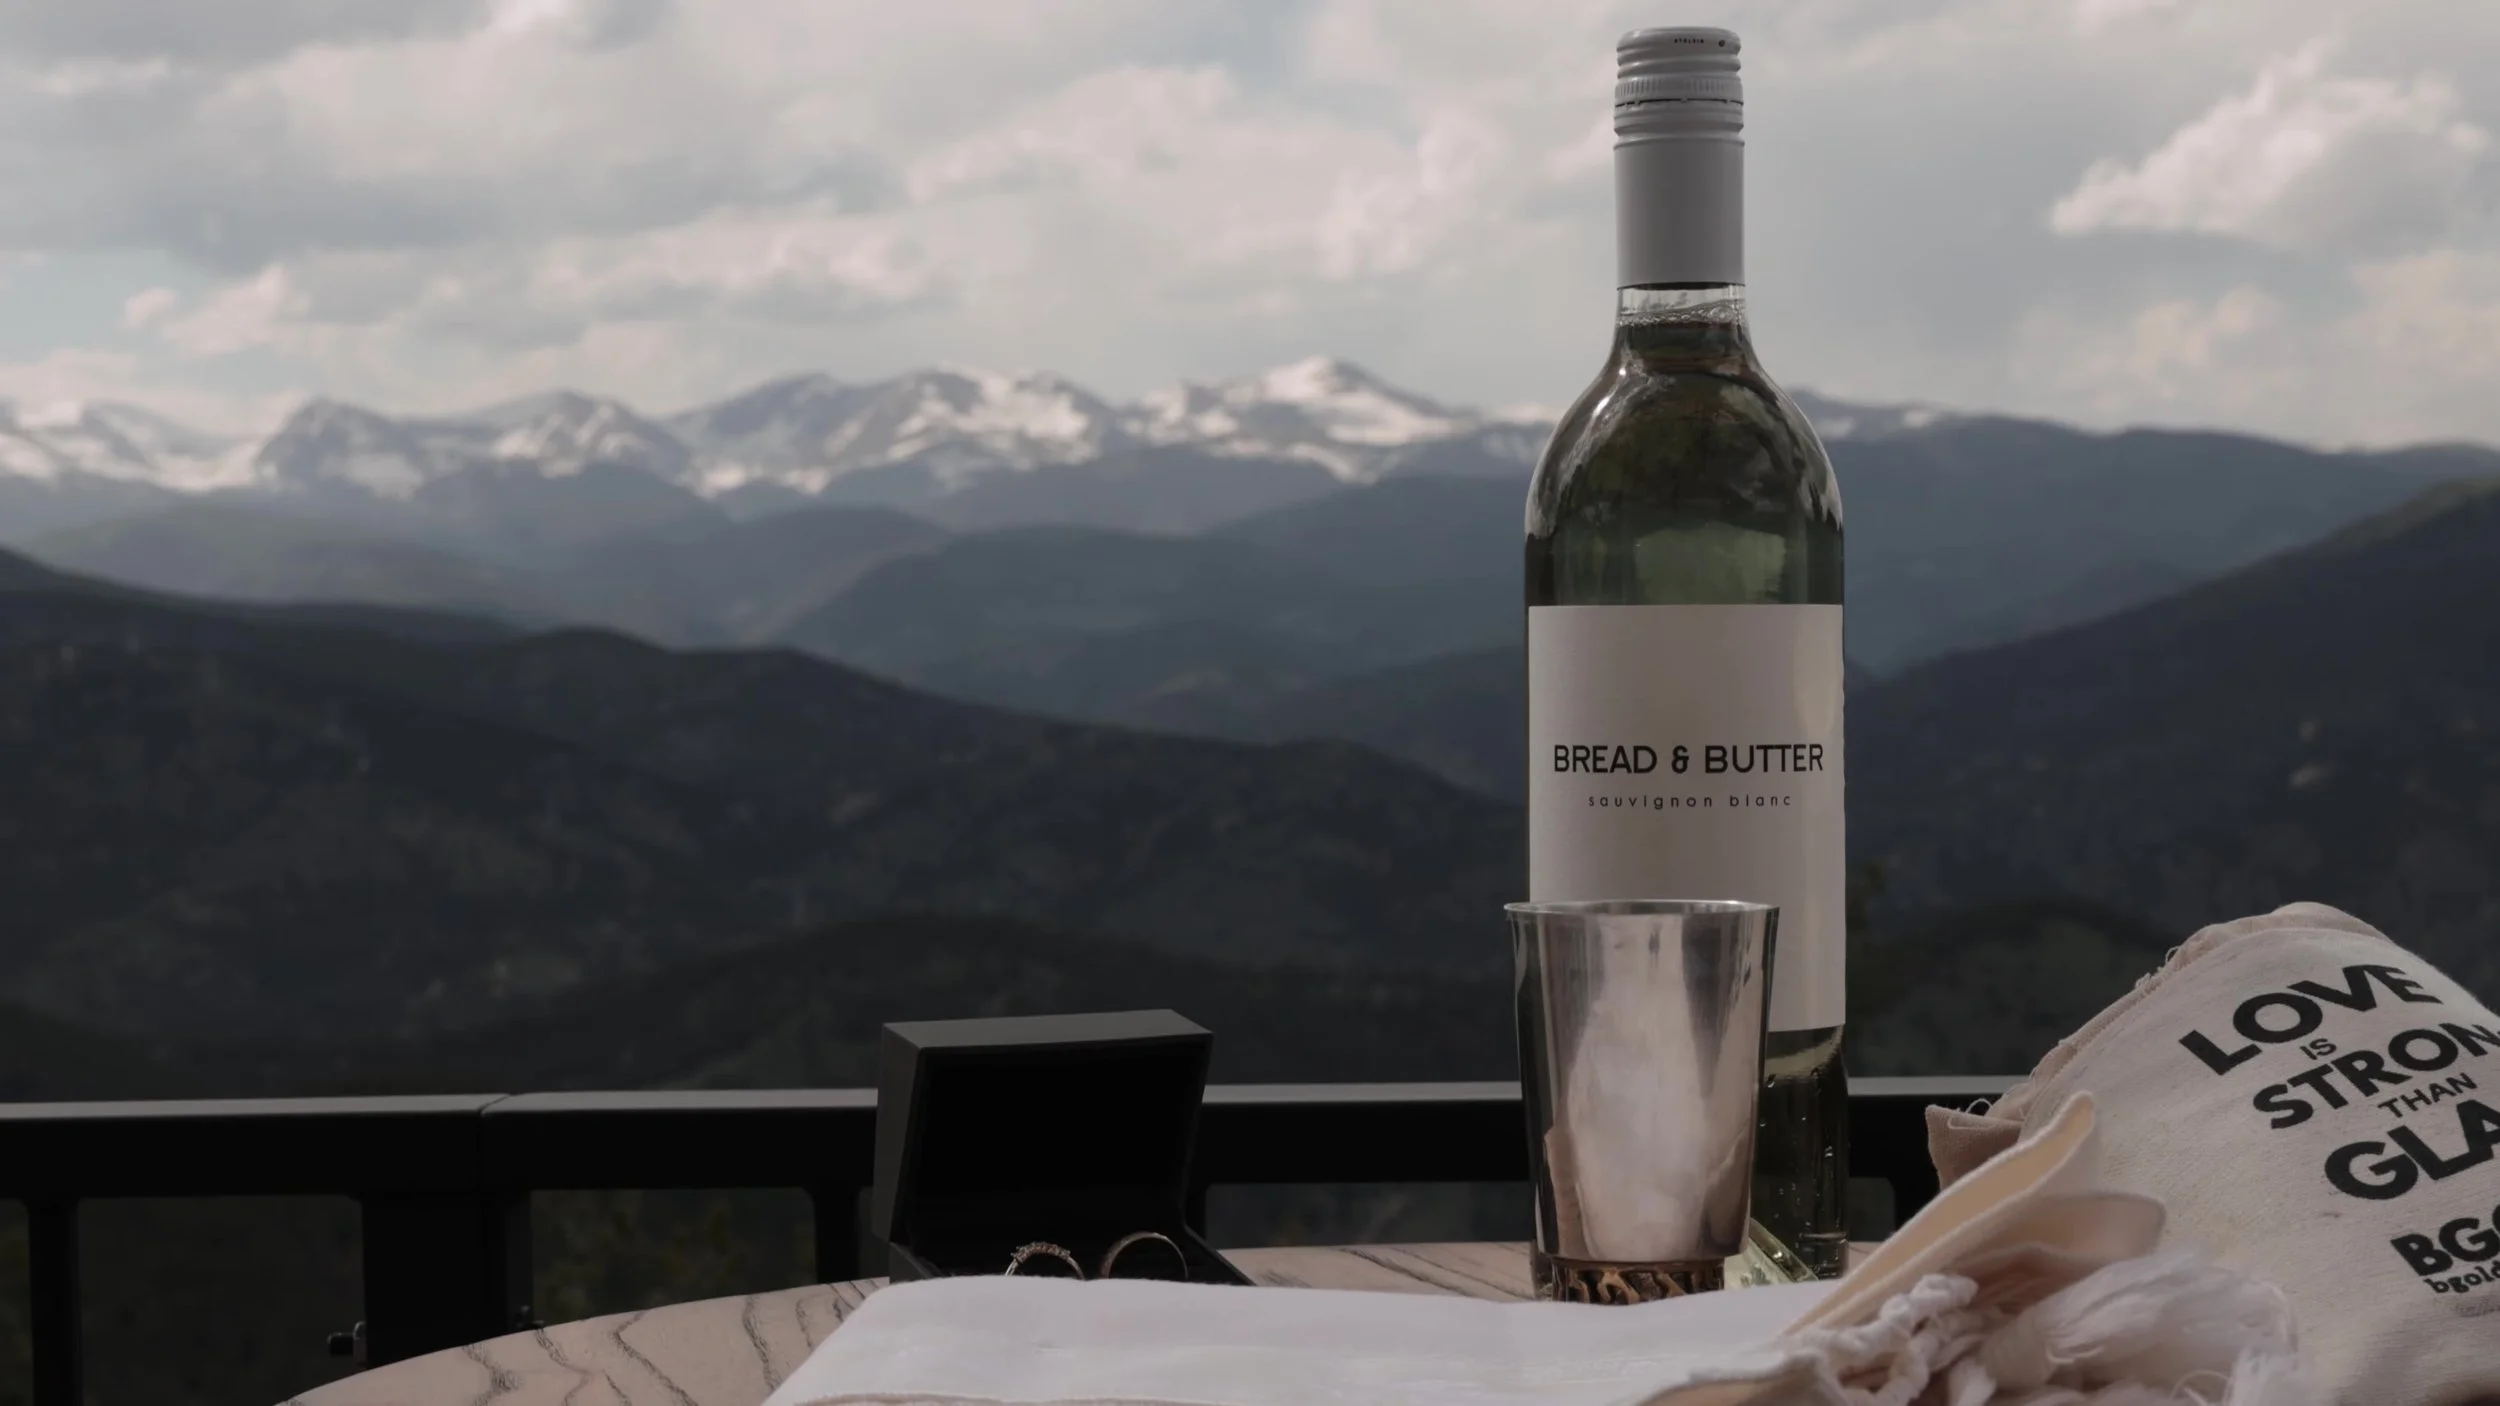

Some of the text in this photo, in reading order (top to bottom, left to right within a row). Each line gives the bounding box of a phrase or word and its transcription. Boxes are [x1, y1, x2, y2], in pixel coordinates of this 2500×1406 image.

[1554, 743, 1824, 774] BREAD & BUTTER
[1588, 794, 1791, 811] sauvignon blanc
[2178, 964, 2442, 1076] LOVE
[2300, 1038, 2338, 1061] IS
[2252, 1022, 2500, 1130] STRON
[2377, 1072, 2478, 1119] THAN
[2324, 1099, 2500, 1200] GLA
